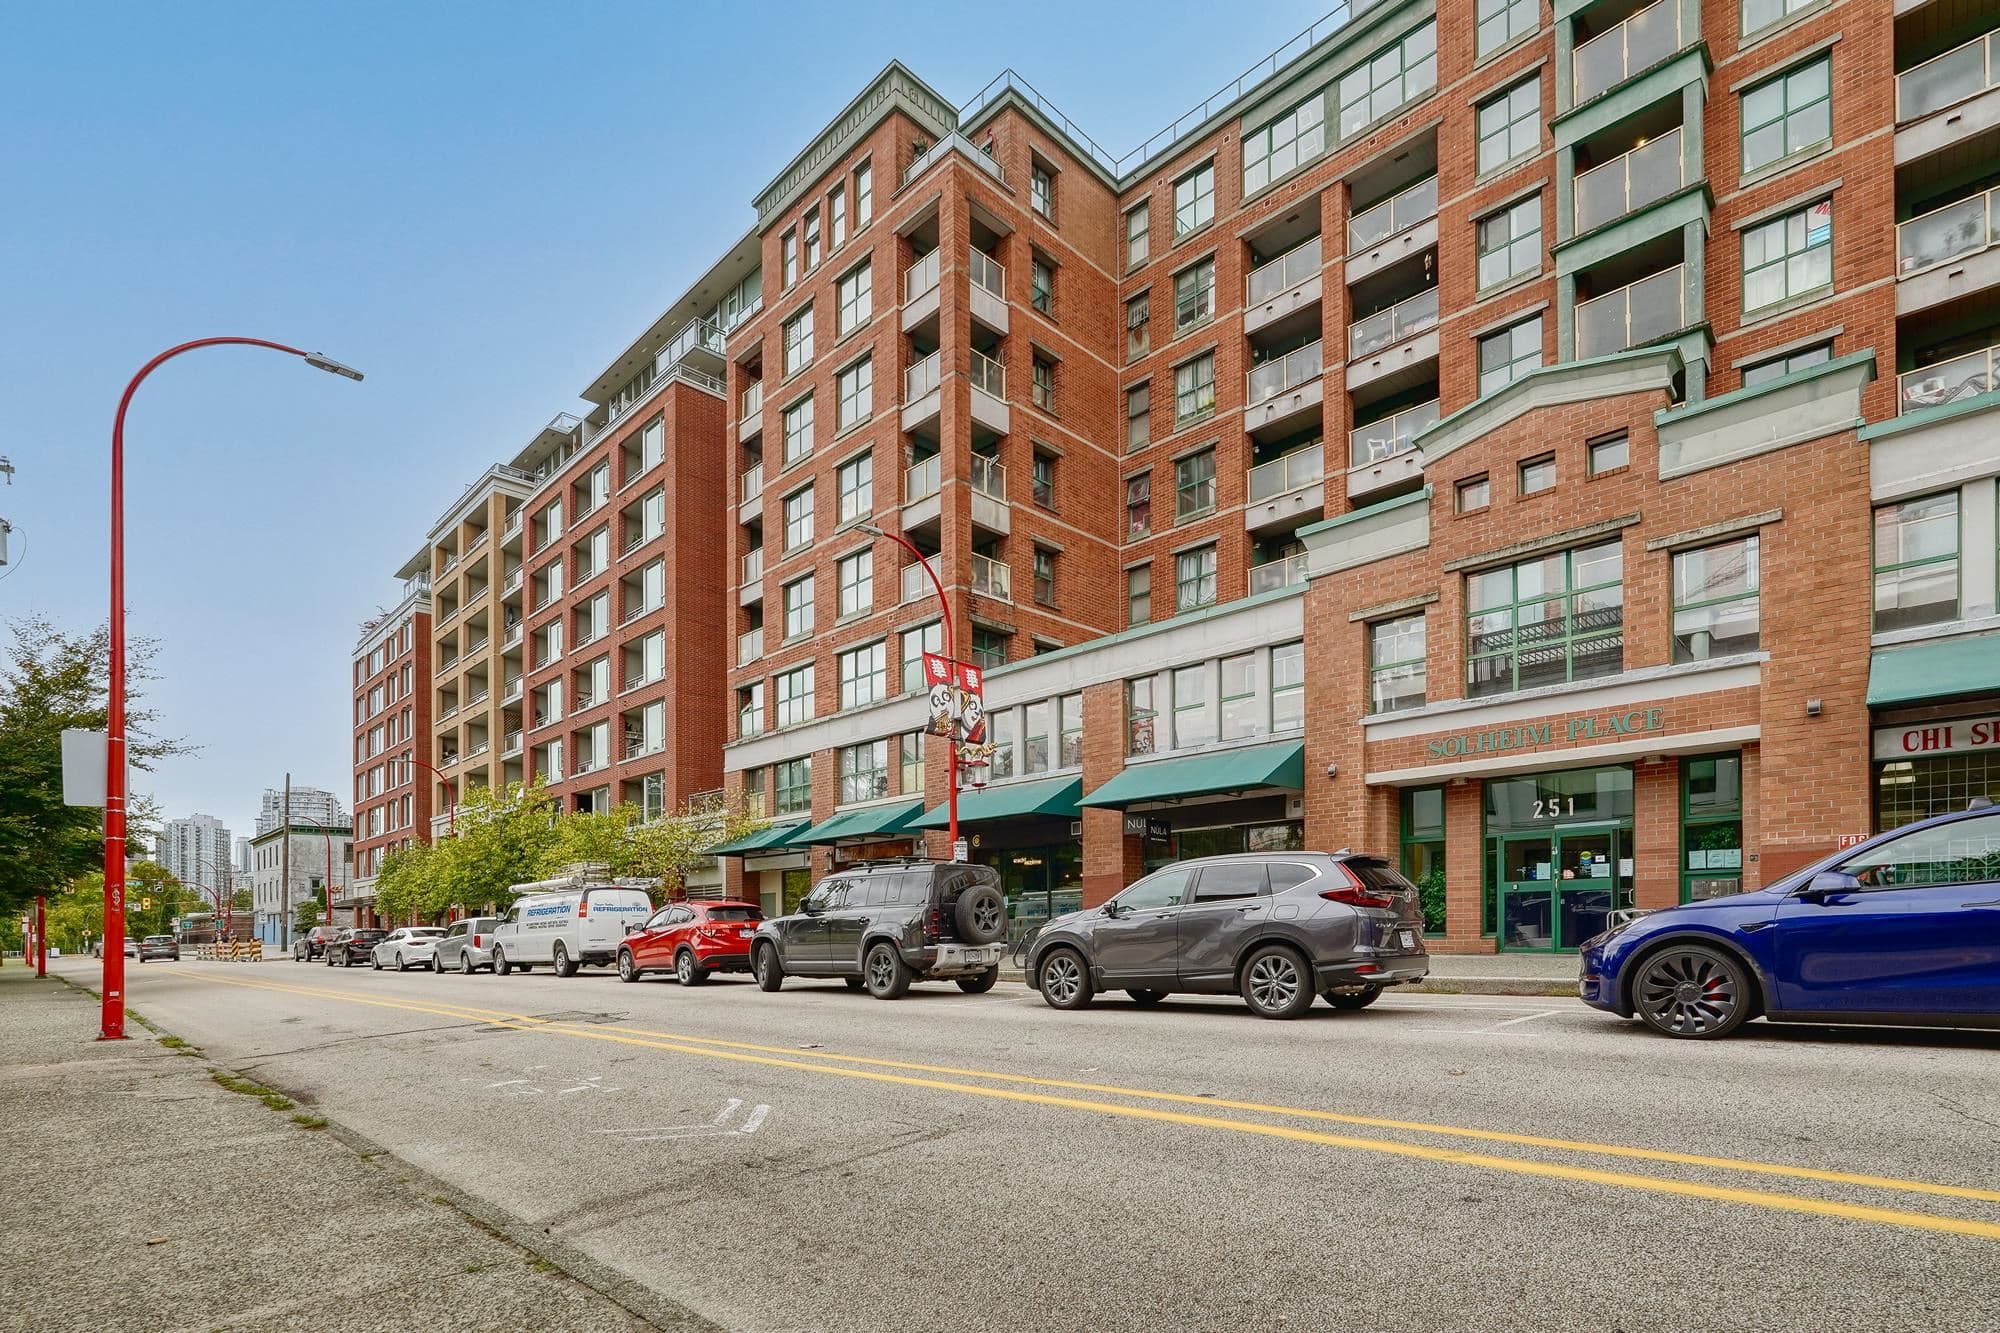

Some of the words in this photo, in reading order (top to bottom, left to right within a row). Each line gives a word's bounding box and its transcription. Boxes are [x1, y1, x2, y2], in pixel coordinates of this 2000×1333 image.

[1427, 724, 1552, 759] SOLHEIM
[1567, 706, 1665, 741] PLACE
[1902, 726, 1953, 752] CHI
[1532, 797, 1575, 819] 251
[526, 905, 572, 917] REFRIGERATION
